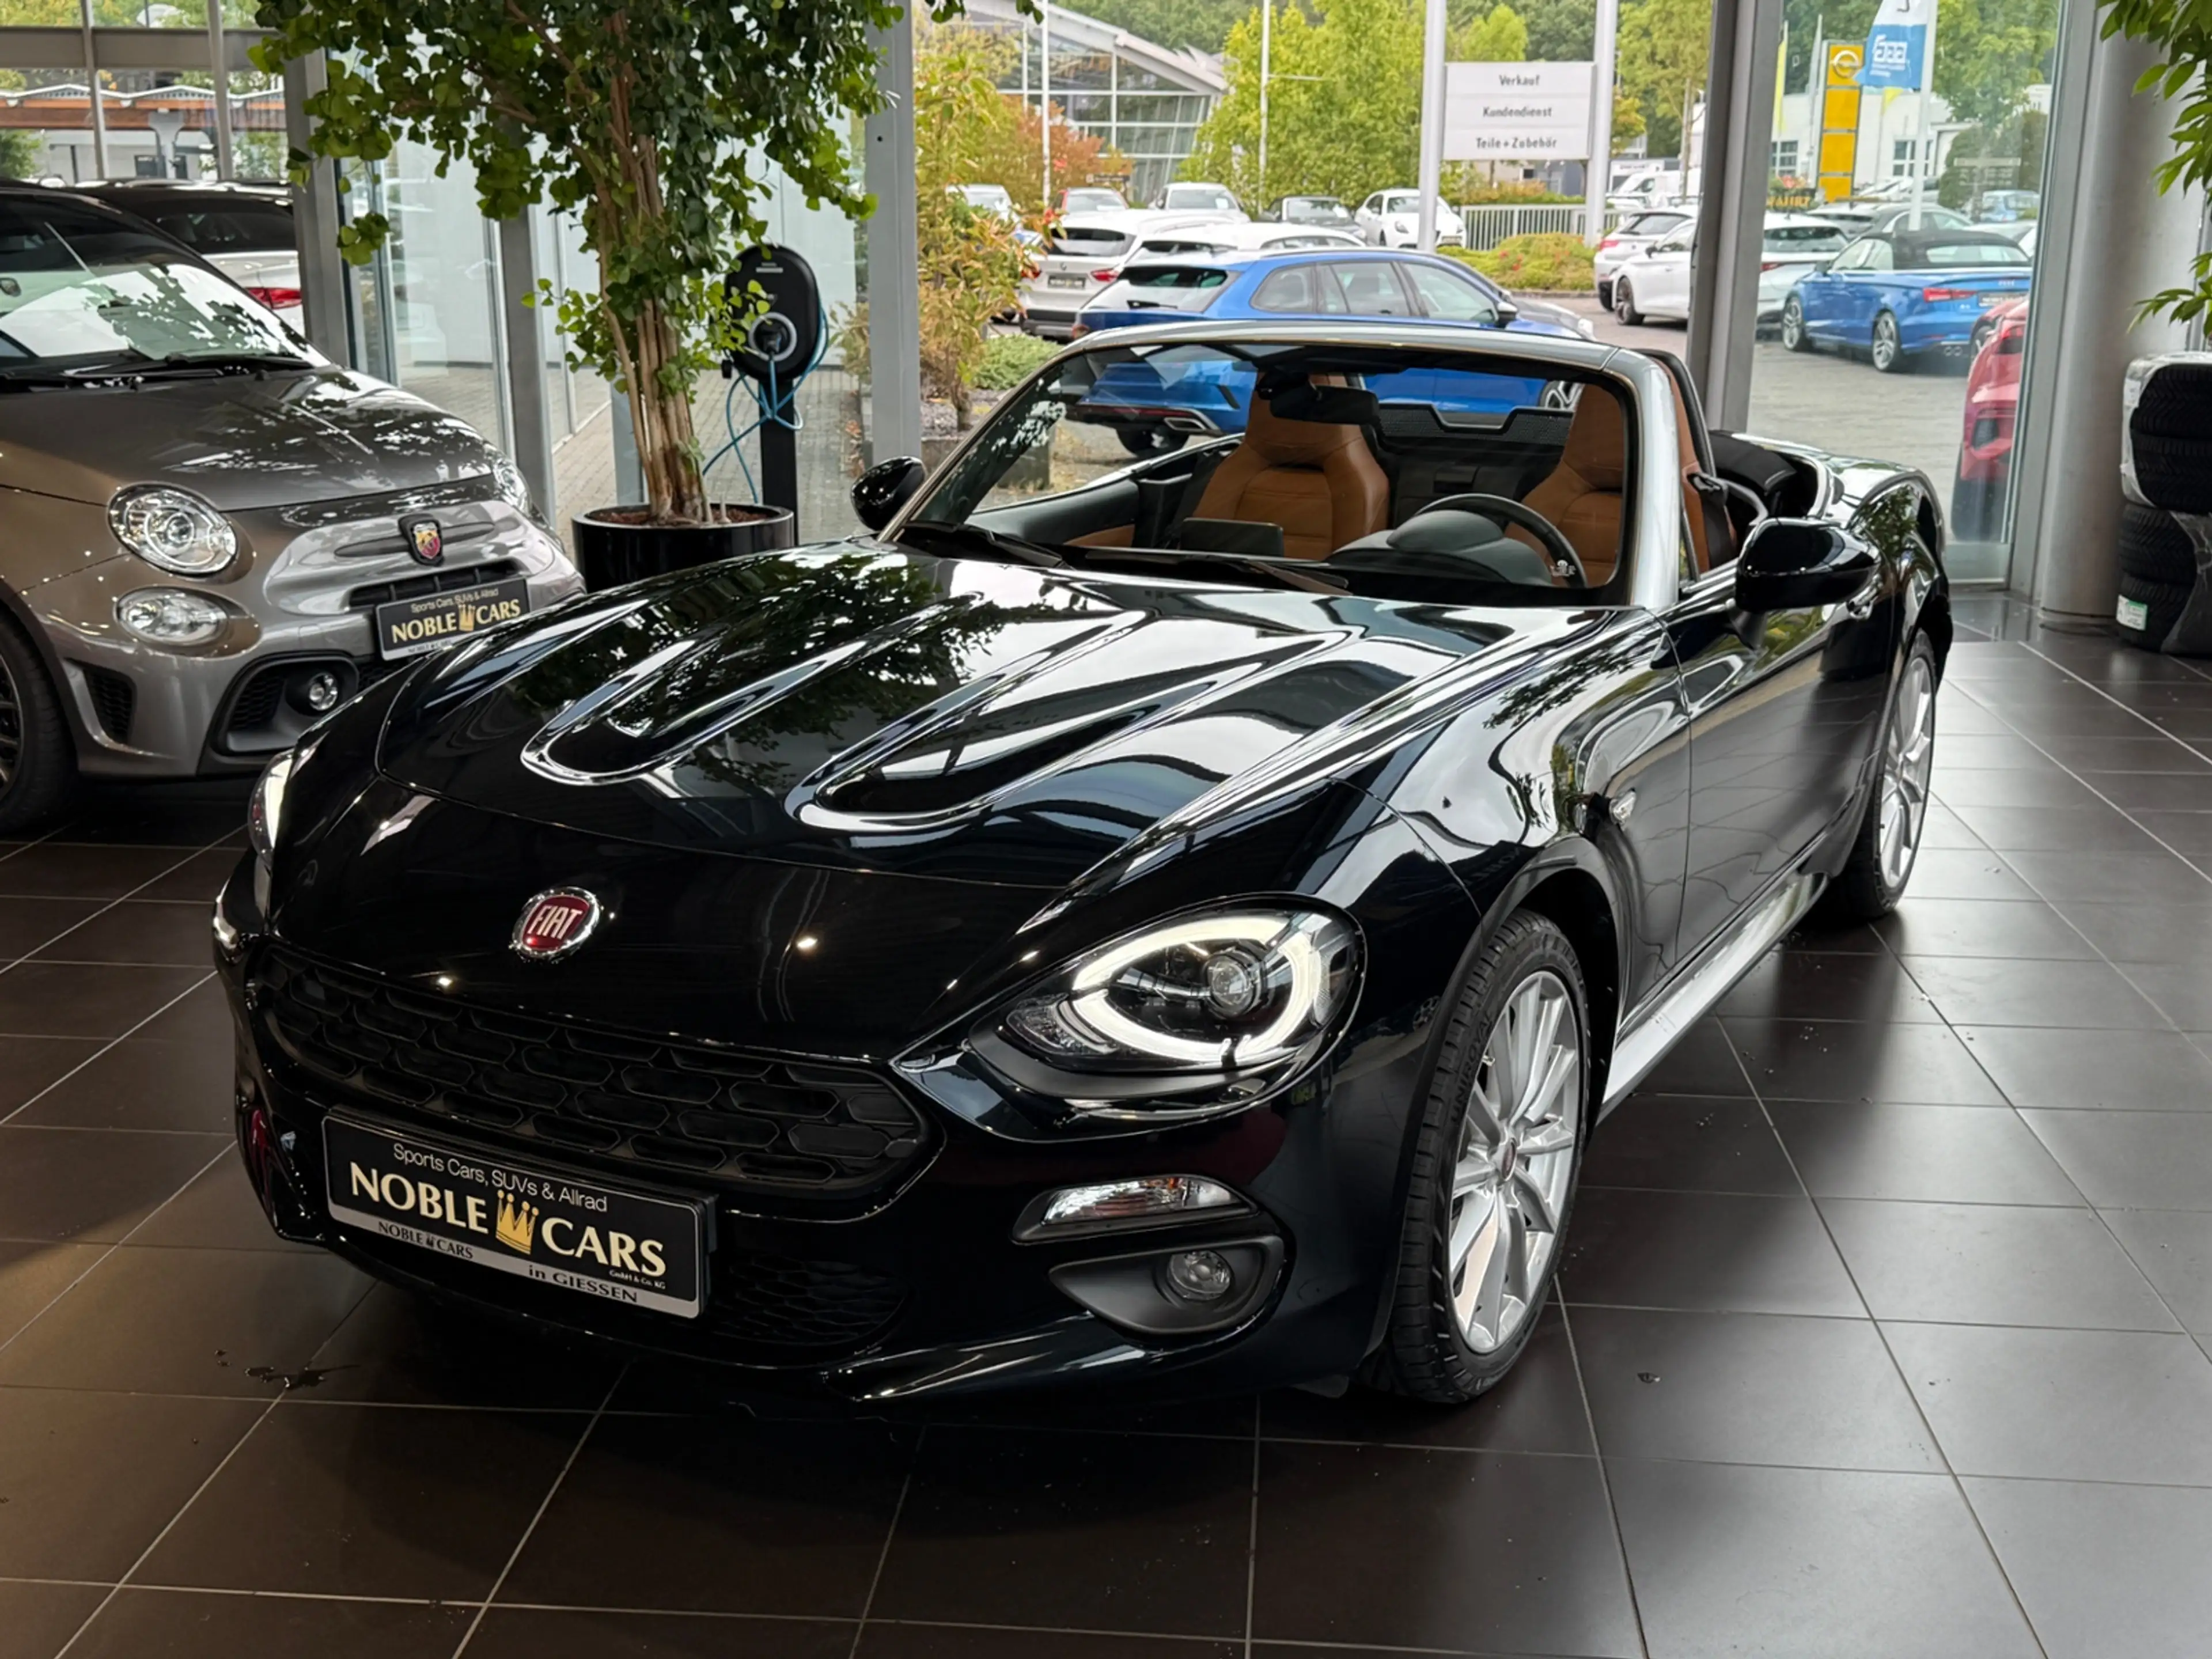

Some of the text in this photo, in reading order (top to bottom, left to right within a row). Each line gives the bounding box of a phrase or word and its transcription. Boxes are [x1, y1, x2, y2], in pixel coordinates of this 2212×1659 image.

[1499, 75, 1540, 86] Verkauf
[1483, 107, 1552, 117] Kundendienst
[1476, 137, 1501, 149] Teile
[1512, 137, 1557, 149] Zubehör
[391, 599, 521, 643] NOBLE CARS
[527, 904, 584, 940] FIAT
[1449, 1009, 1493, 1123] UNIROYAL
[393, 1143, 608, 1213] Sports Cars, SUVs & Allrad
[350, 1161, 666, 1277] NOBLE CARS
[378, 1221, 474, 1259] NOBLE CARS
[529, 1265, 638, 1303] in GIESSEN
